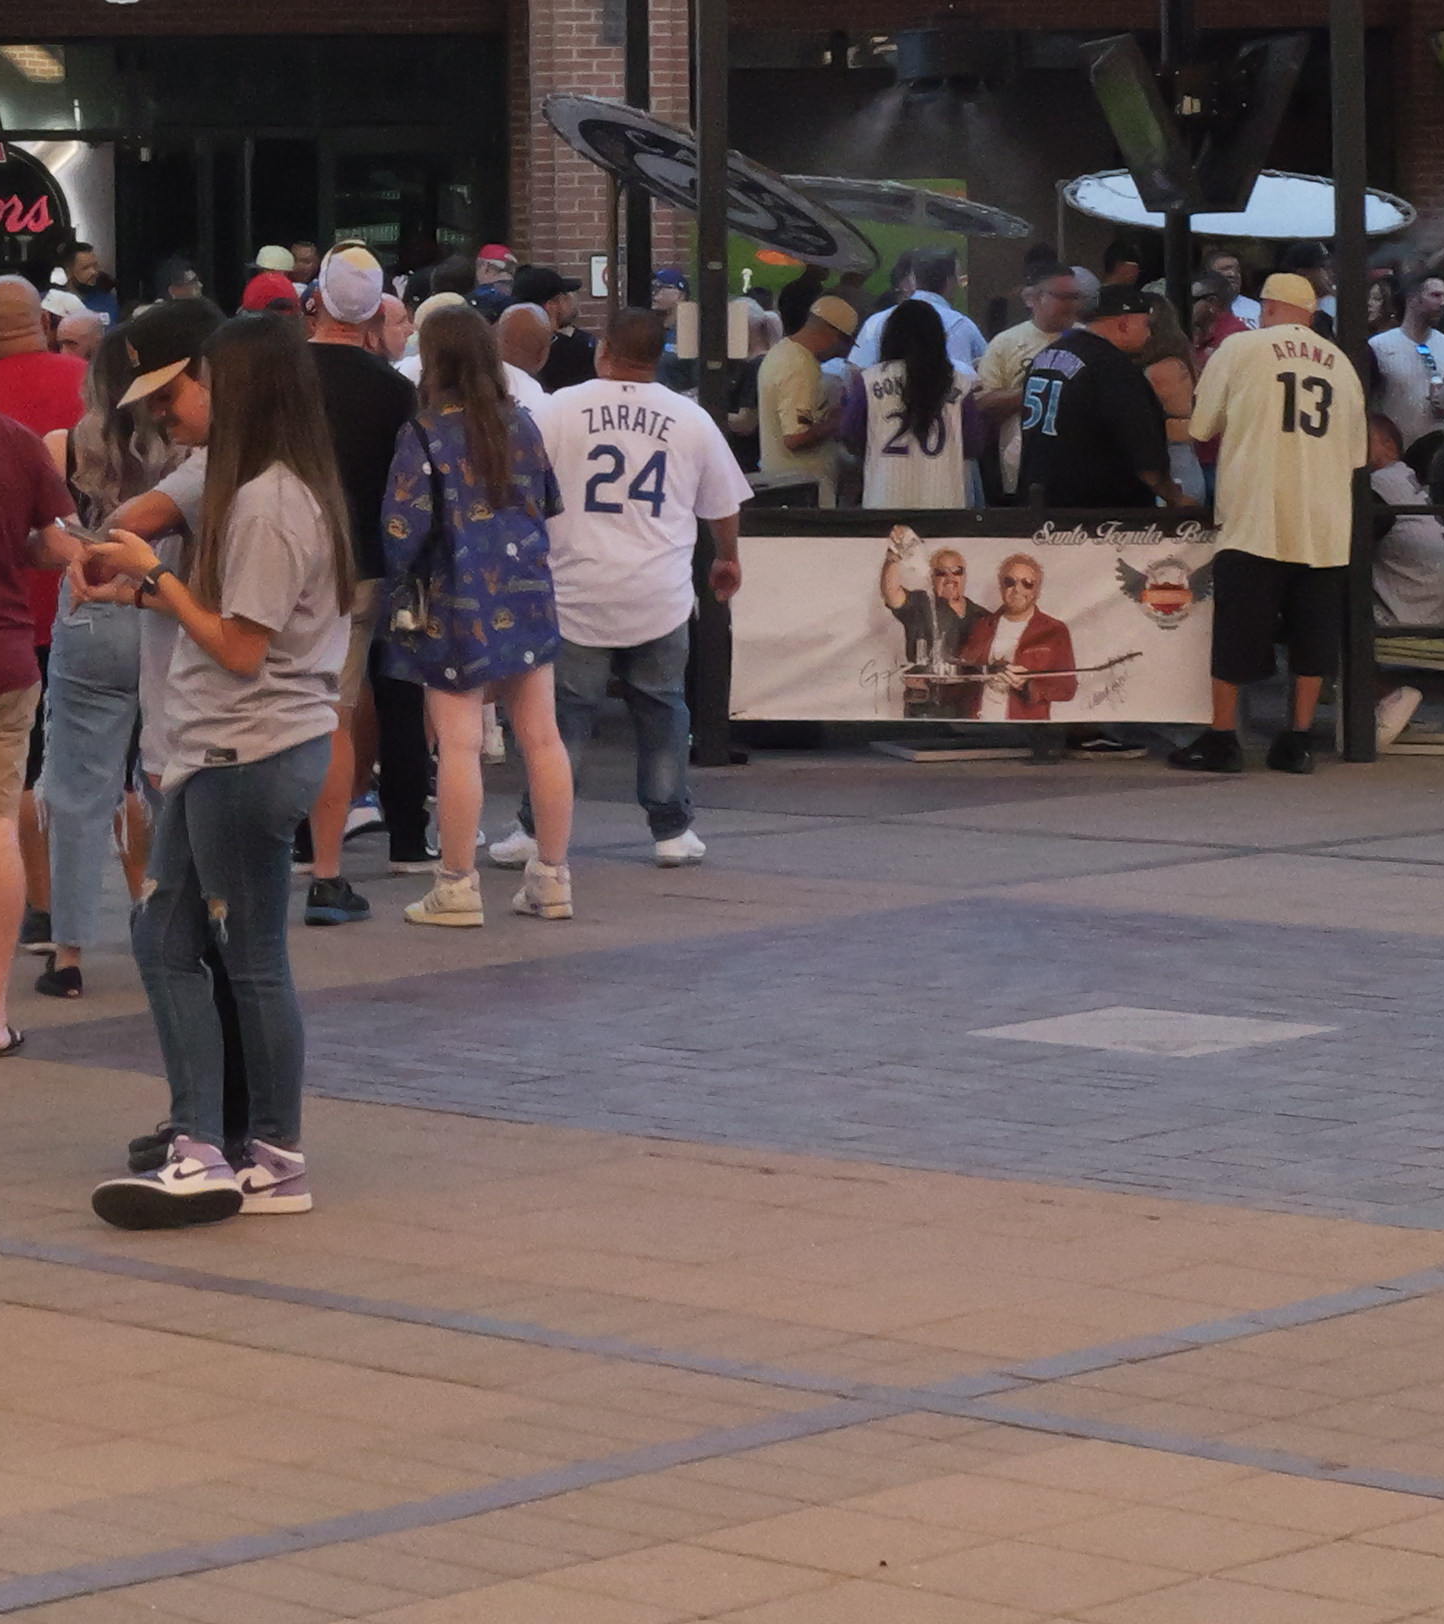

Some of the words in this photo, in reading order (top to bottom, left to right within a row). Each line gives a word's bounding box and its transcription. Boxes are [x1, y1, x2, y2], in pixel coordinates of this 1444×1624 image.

[1272, 339, 1337, 372] ARANA
[581, 403, 676, 443] ZARATE
[1022, 376, 1064, 437] 51
[1275, 370, 1334, 439] 13
[881, 408, 947, 458] 20
[584, 443, 667, 518] 24
[1032, 520, 1088, 546] Santo
[1092, 520, 1164, 553] Tequila
